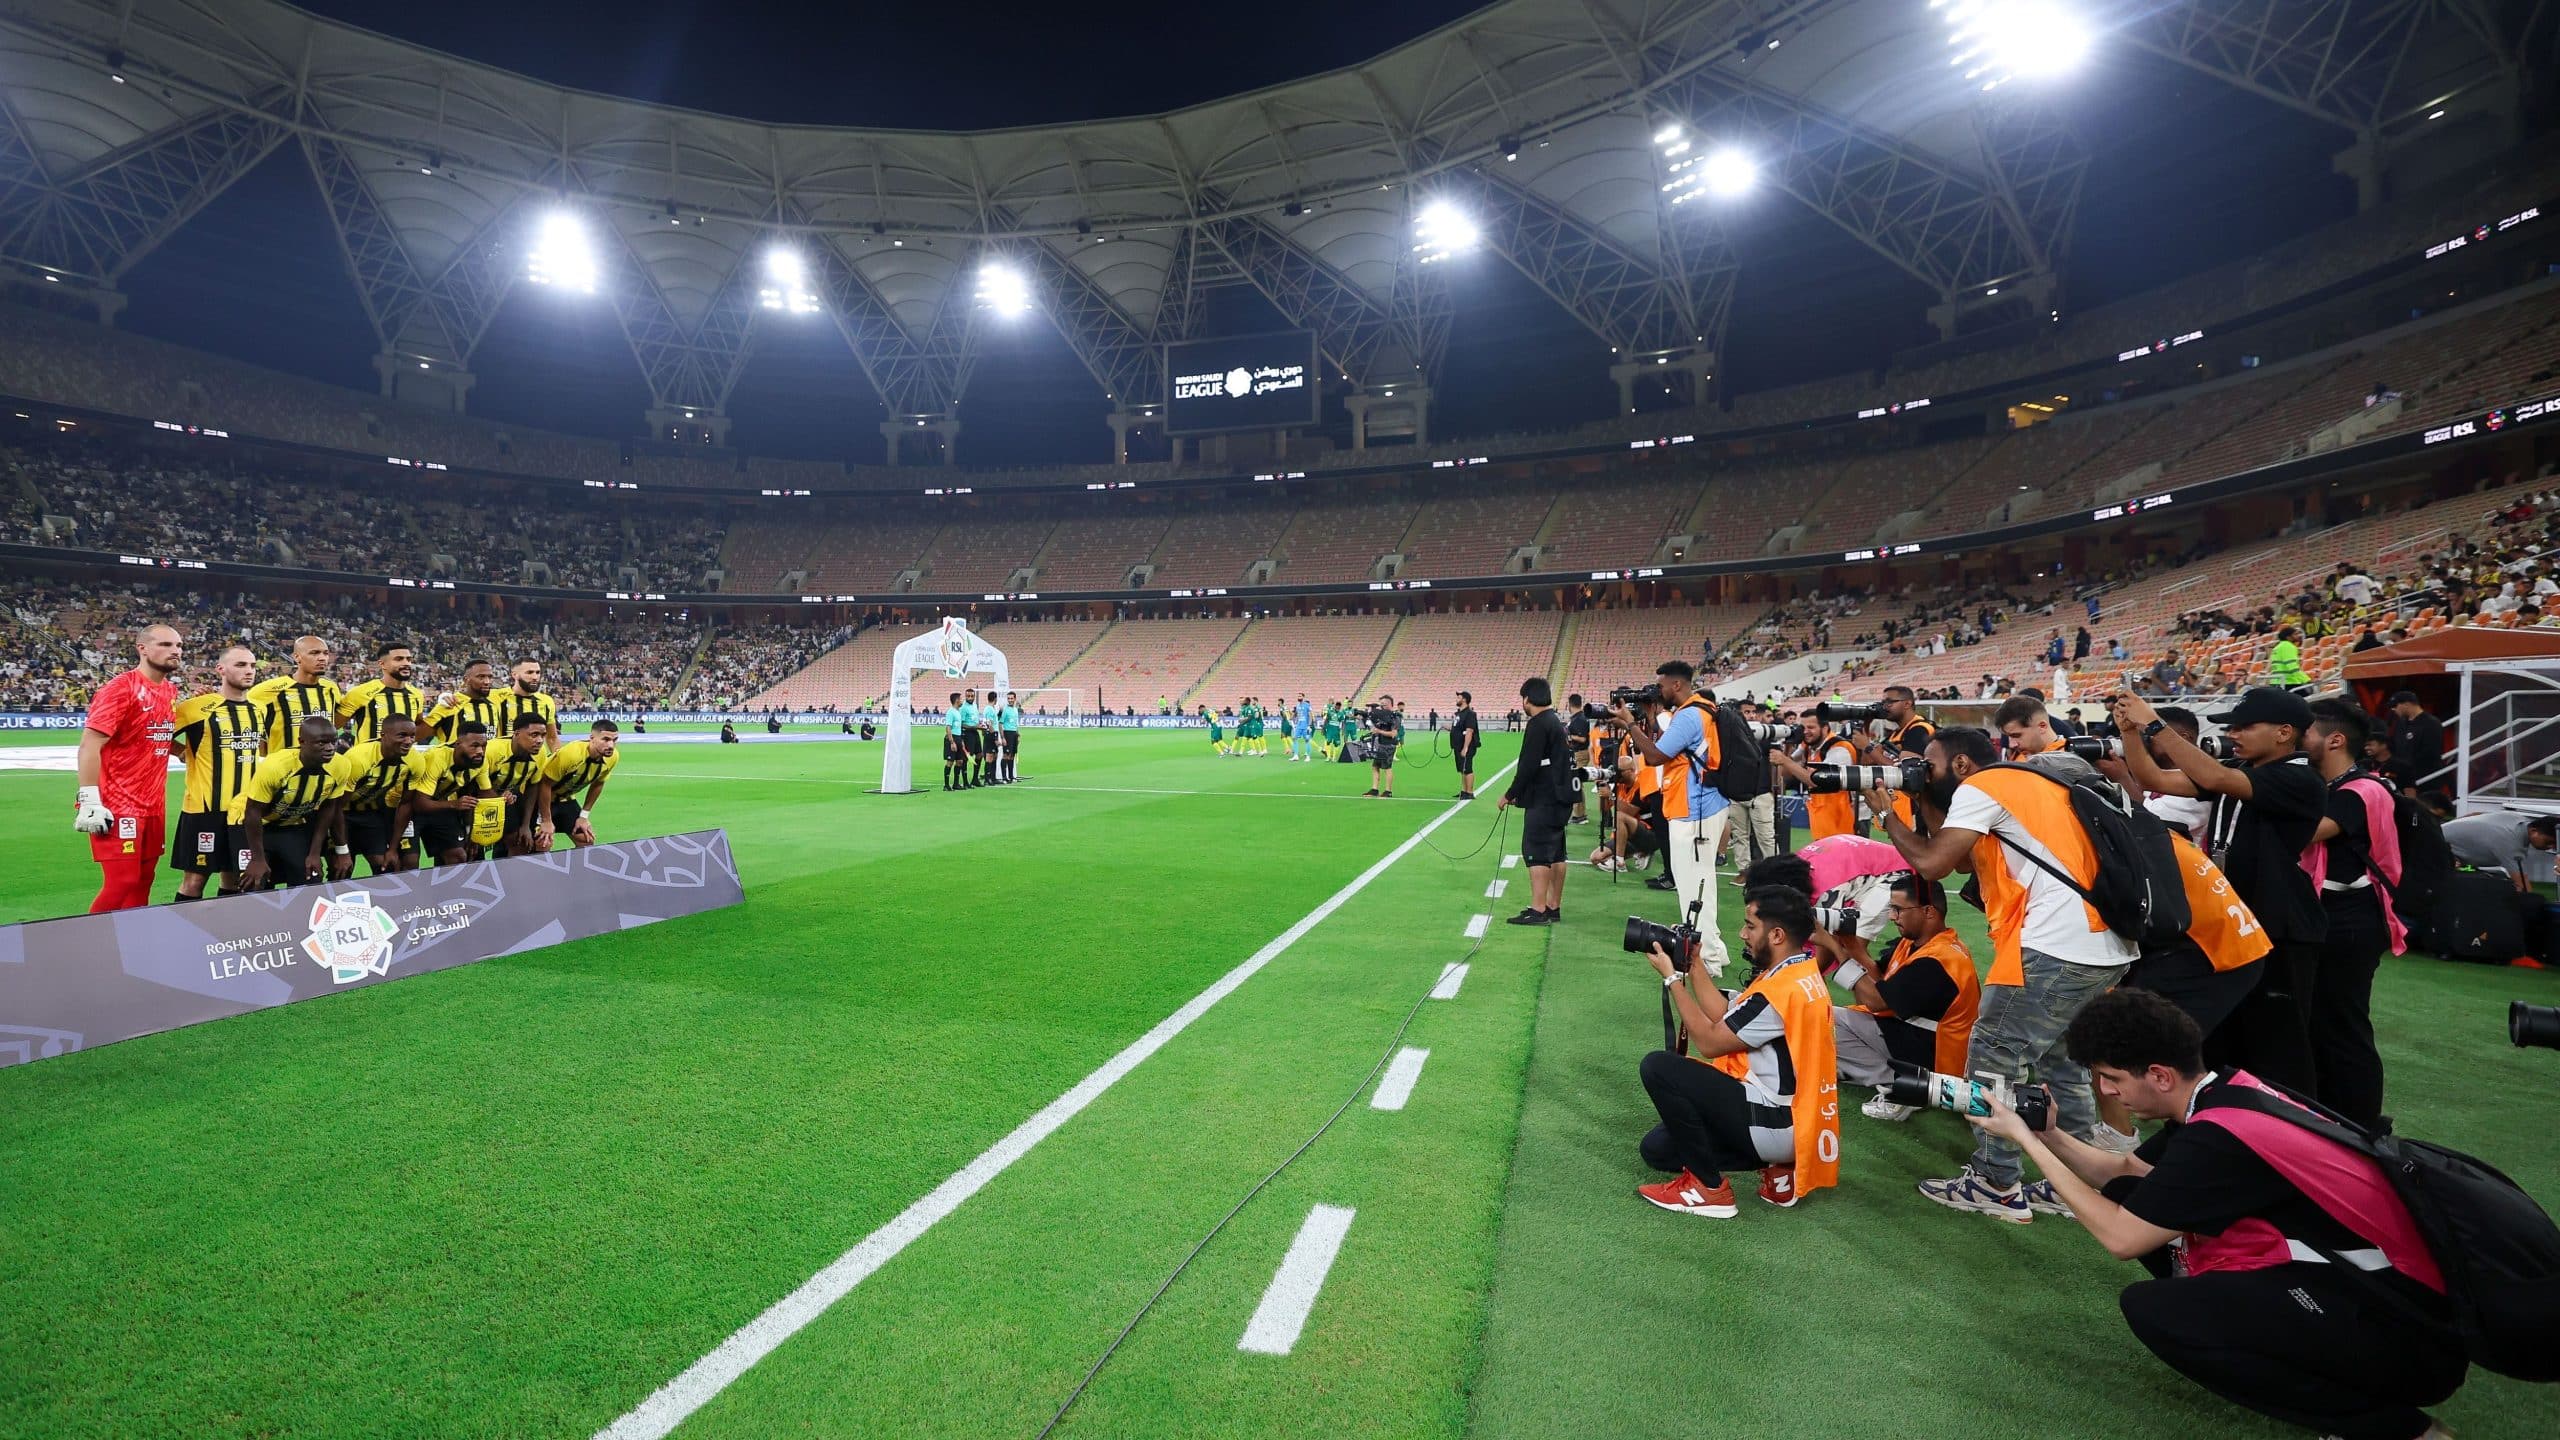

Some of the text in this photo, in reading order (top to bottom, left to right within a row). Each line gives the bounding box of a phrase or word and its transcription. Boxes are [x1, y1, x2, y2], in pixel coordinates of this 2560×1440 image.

[2521, 207, 2540, 221] RSL
[2448, 236, 2468, 250] RSL
[1175, 382, 1223, 399] LEAGUE
[2545, 398, 2560, 412] RS
[2453, 421, 2476, 437] RSL
[951, 641, 963, 653] RSL
[915, 652, 935, 665] LEAGUE
[45, 716, 88, 729] ROSH
[558, 714, 580, 722] OSHN
[649, 714, 717, 723] ROSHN SAUDI LEAGUE
[747, 715, 767, 723] SAUDI
[800, 715, 823, 724] ROSHN
[1083, 717, 1107, 727] SAUDI
[1108, 717, 1138, 727] LEAGUE
[1150, 717, 1180, 728] ROSHN
[231, 741, 259, 750] ROSHN
[402, 902, 466, 922] دوري روشن
[335, 925, 369, 946] RSL
[407, 914, 471, 945] السعودي
[206, 931, 292, 956] ROSHN SAUDI
[209, 947, 297, 980] LEAGUE
[1680, 1188, 1705, 1206] N
